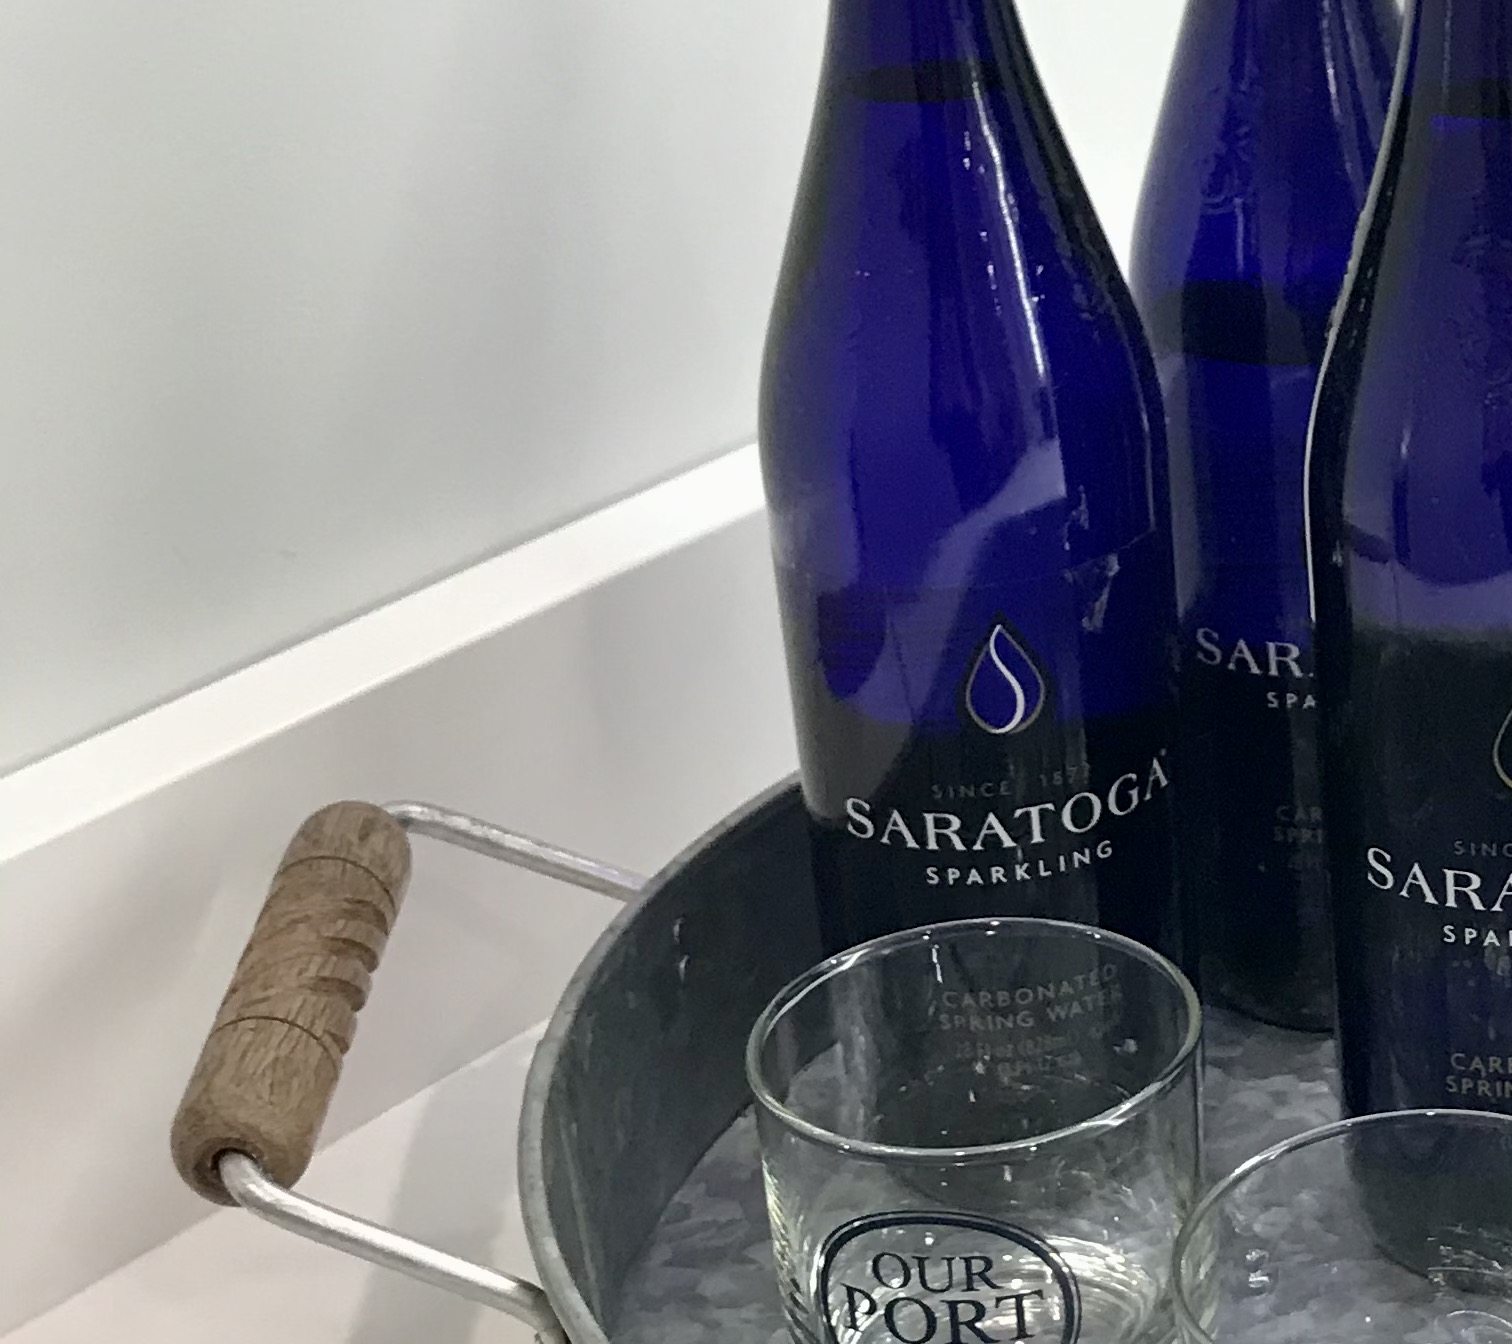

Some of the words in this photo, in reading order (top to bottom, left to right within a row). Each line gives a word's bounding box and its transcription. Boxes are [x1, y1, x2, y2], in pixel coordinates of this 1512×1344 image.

[846, 756, 1169, 852] SARATOGA
[930, 778, 1013, 801] SINCE
[925, 840, 1113, 886] SPARKLING
[941, 963, 1117, 1010] CARBONATED
[938, 1010, 1035, 1033] SPRING
[872, 1251, 1003, 1293] OUR
